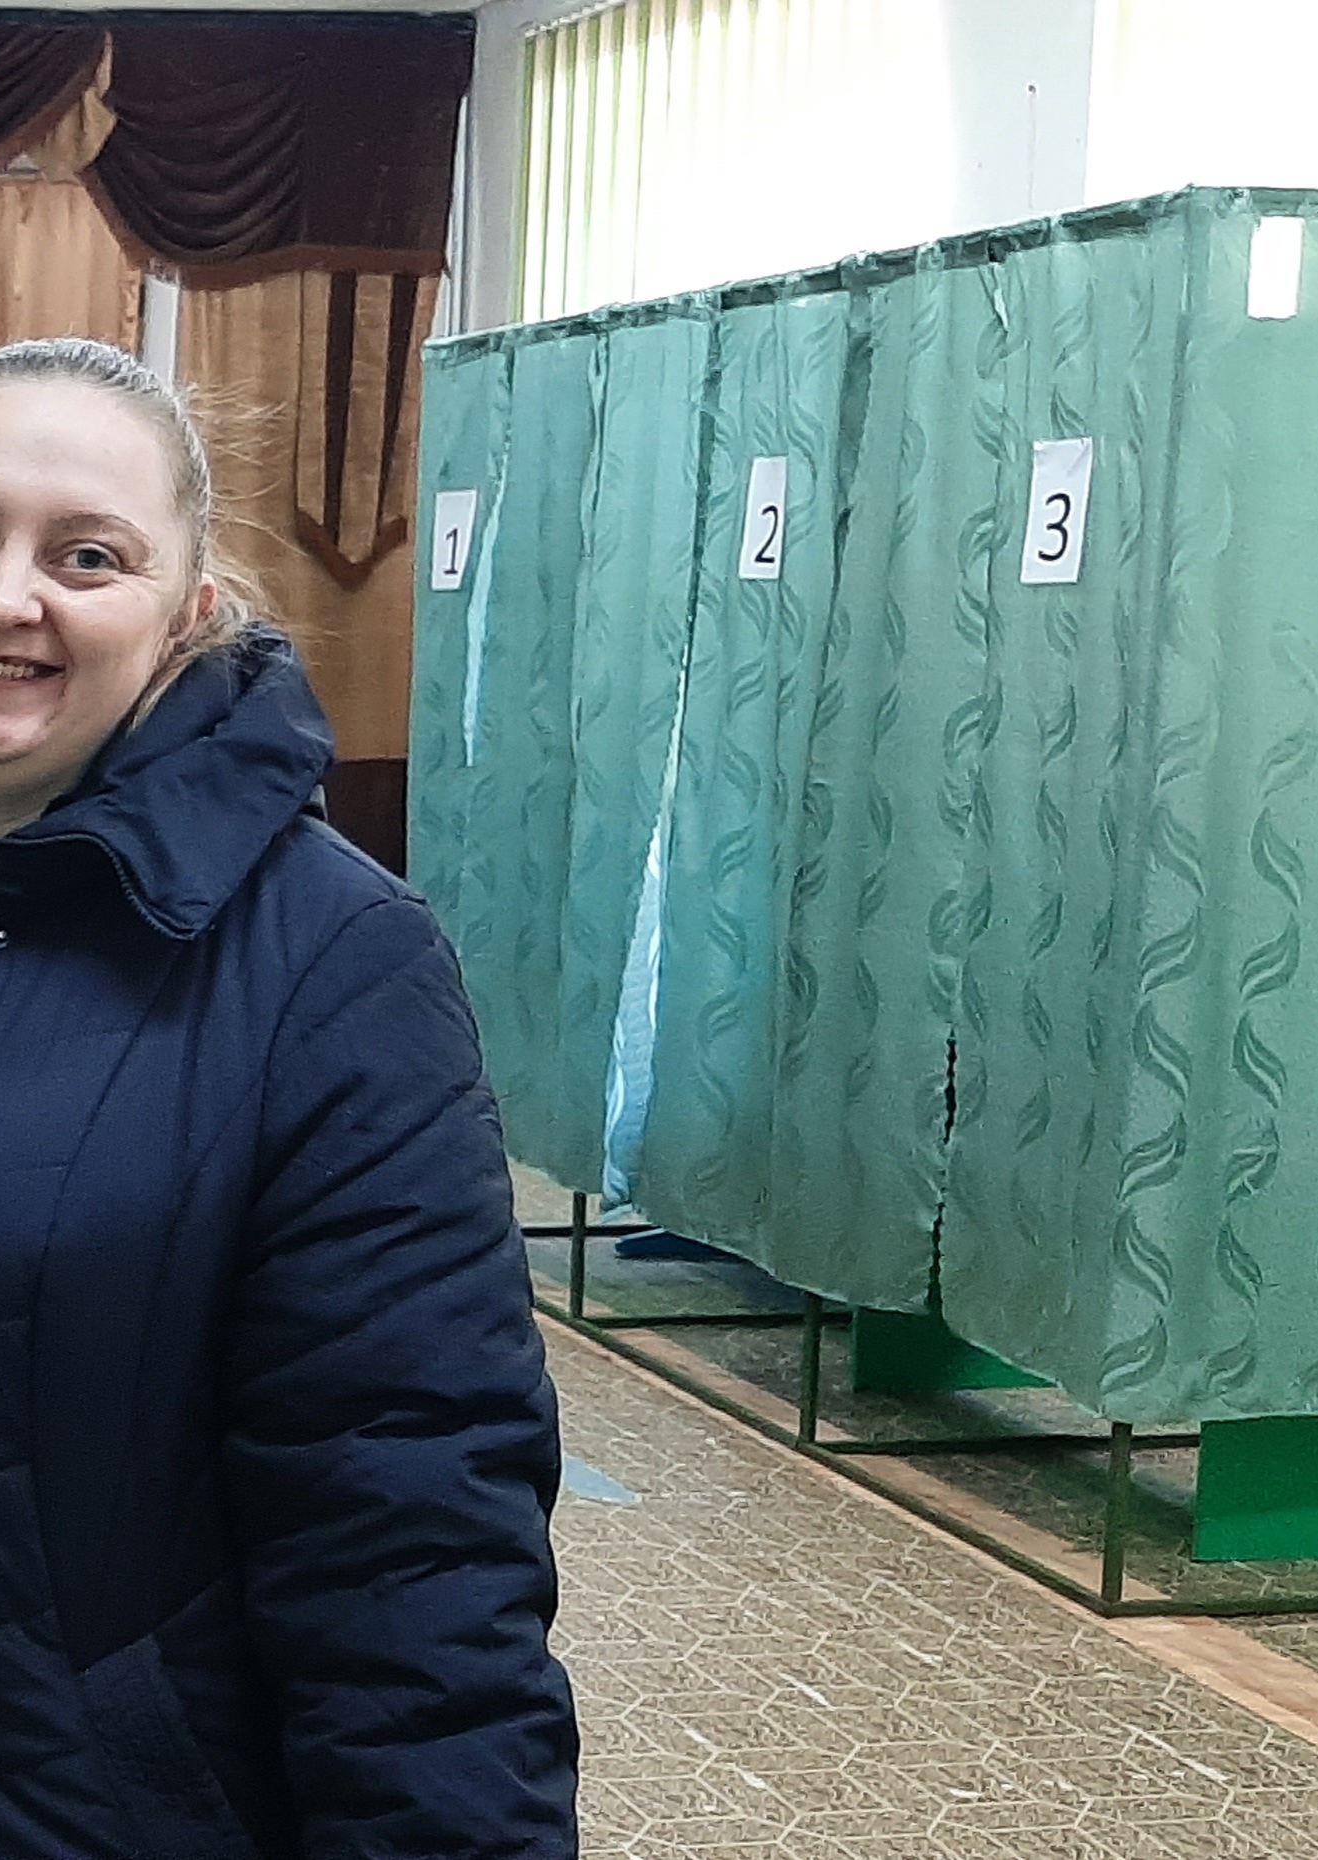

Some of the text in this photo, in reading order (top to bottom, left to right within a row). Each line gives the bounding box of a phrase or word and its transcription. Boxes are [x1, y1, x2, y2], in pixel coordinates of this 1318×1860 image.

[444, 528, 461, 575] 1
[753, 505, 779, 564] 2
[1036, 492, 1072, 562] 3
